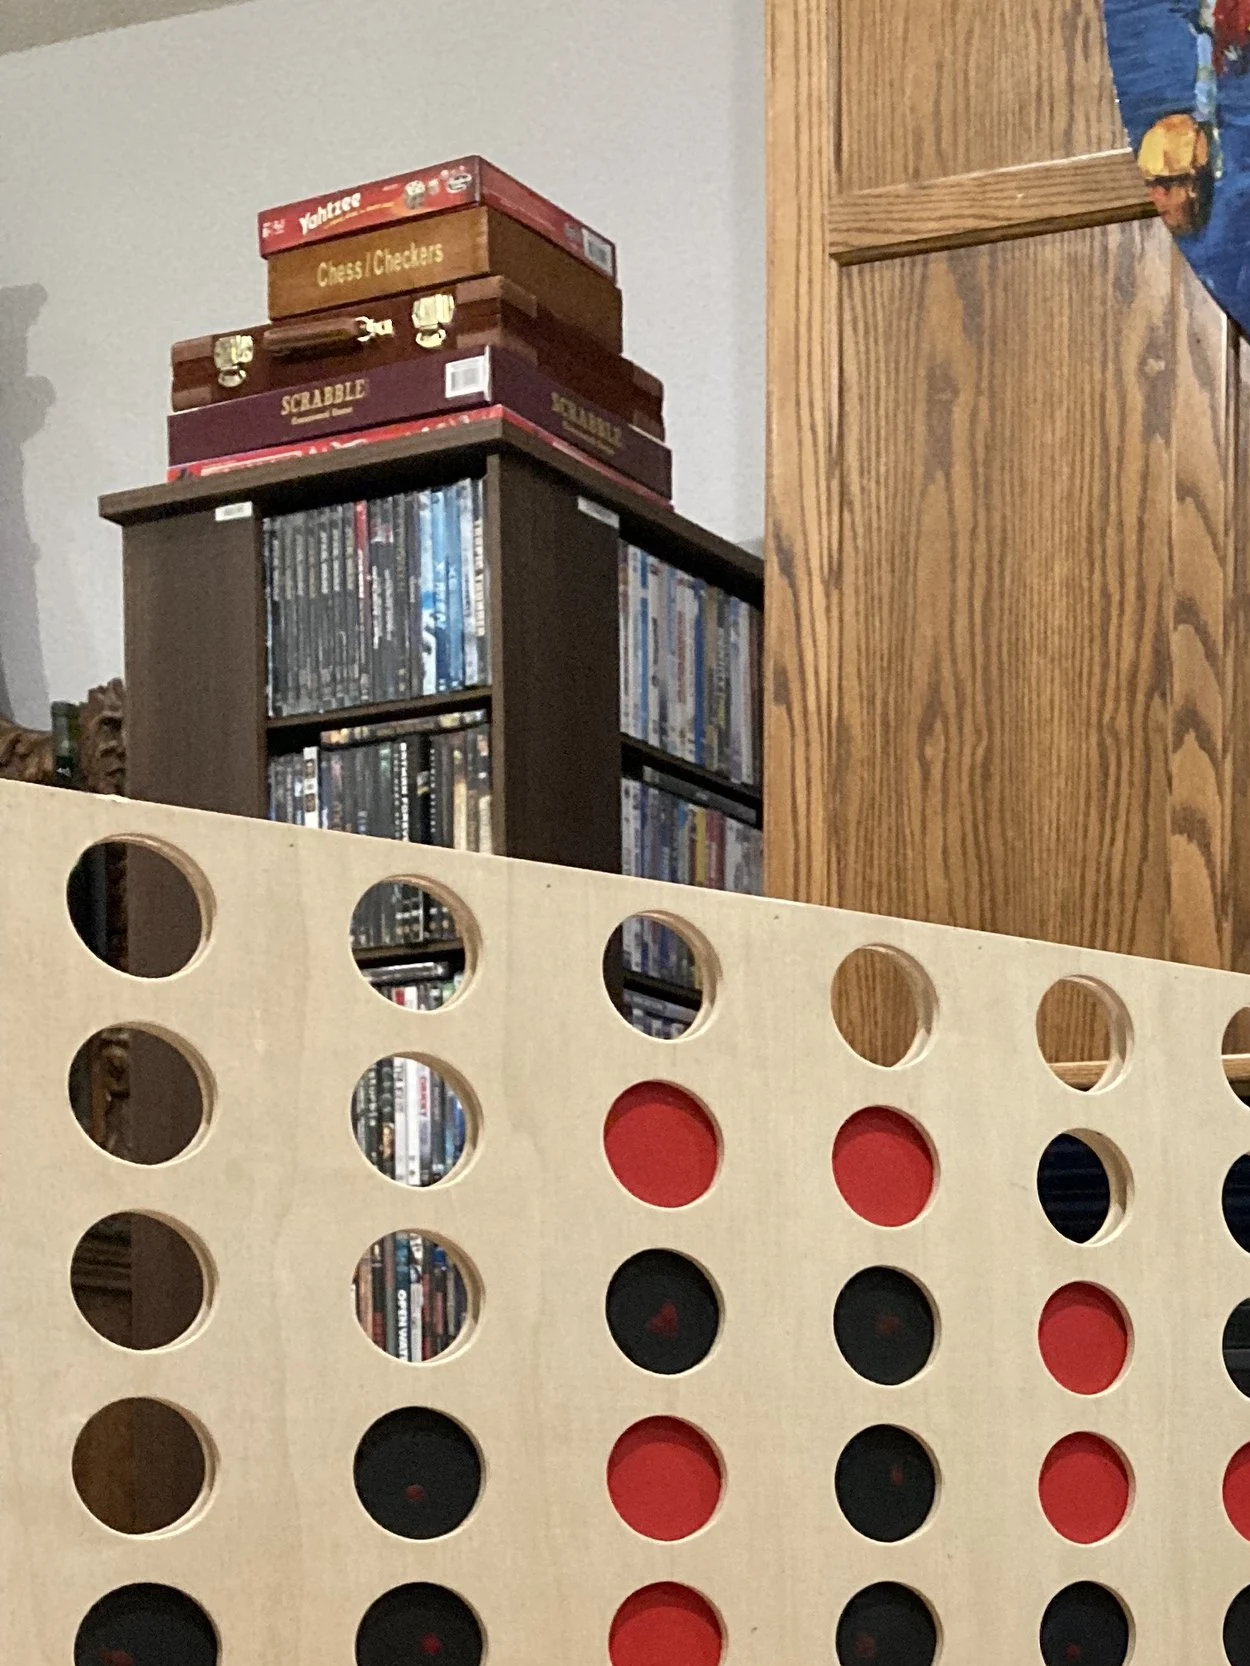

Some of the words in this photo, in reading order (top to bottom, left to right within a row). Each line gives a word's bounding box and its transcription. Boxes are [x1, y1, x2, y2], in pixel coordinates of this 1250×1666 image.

[299, 193, 361, 235] Yahtzee
[281, 379, 365, 415] SCRABBLE
[399, 742, 408, 794] BATMAN
[397, 1288, 408, 1328] OPEN
